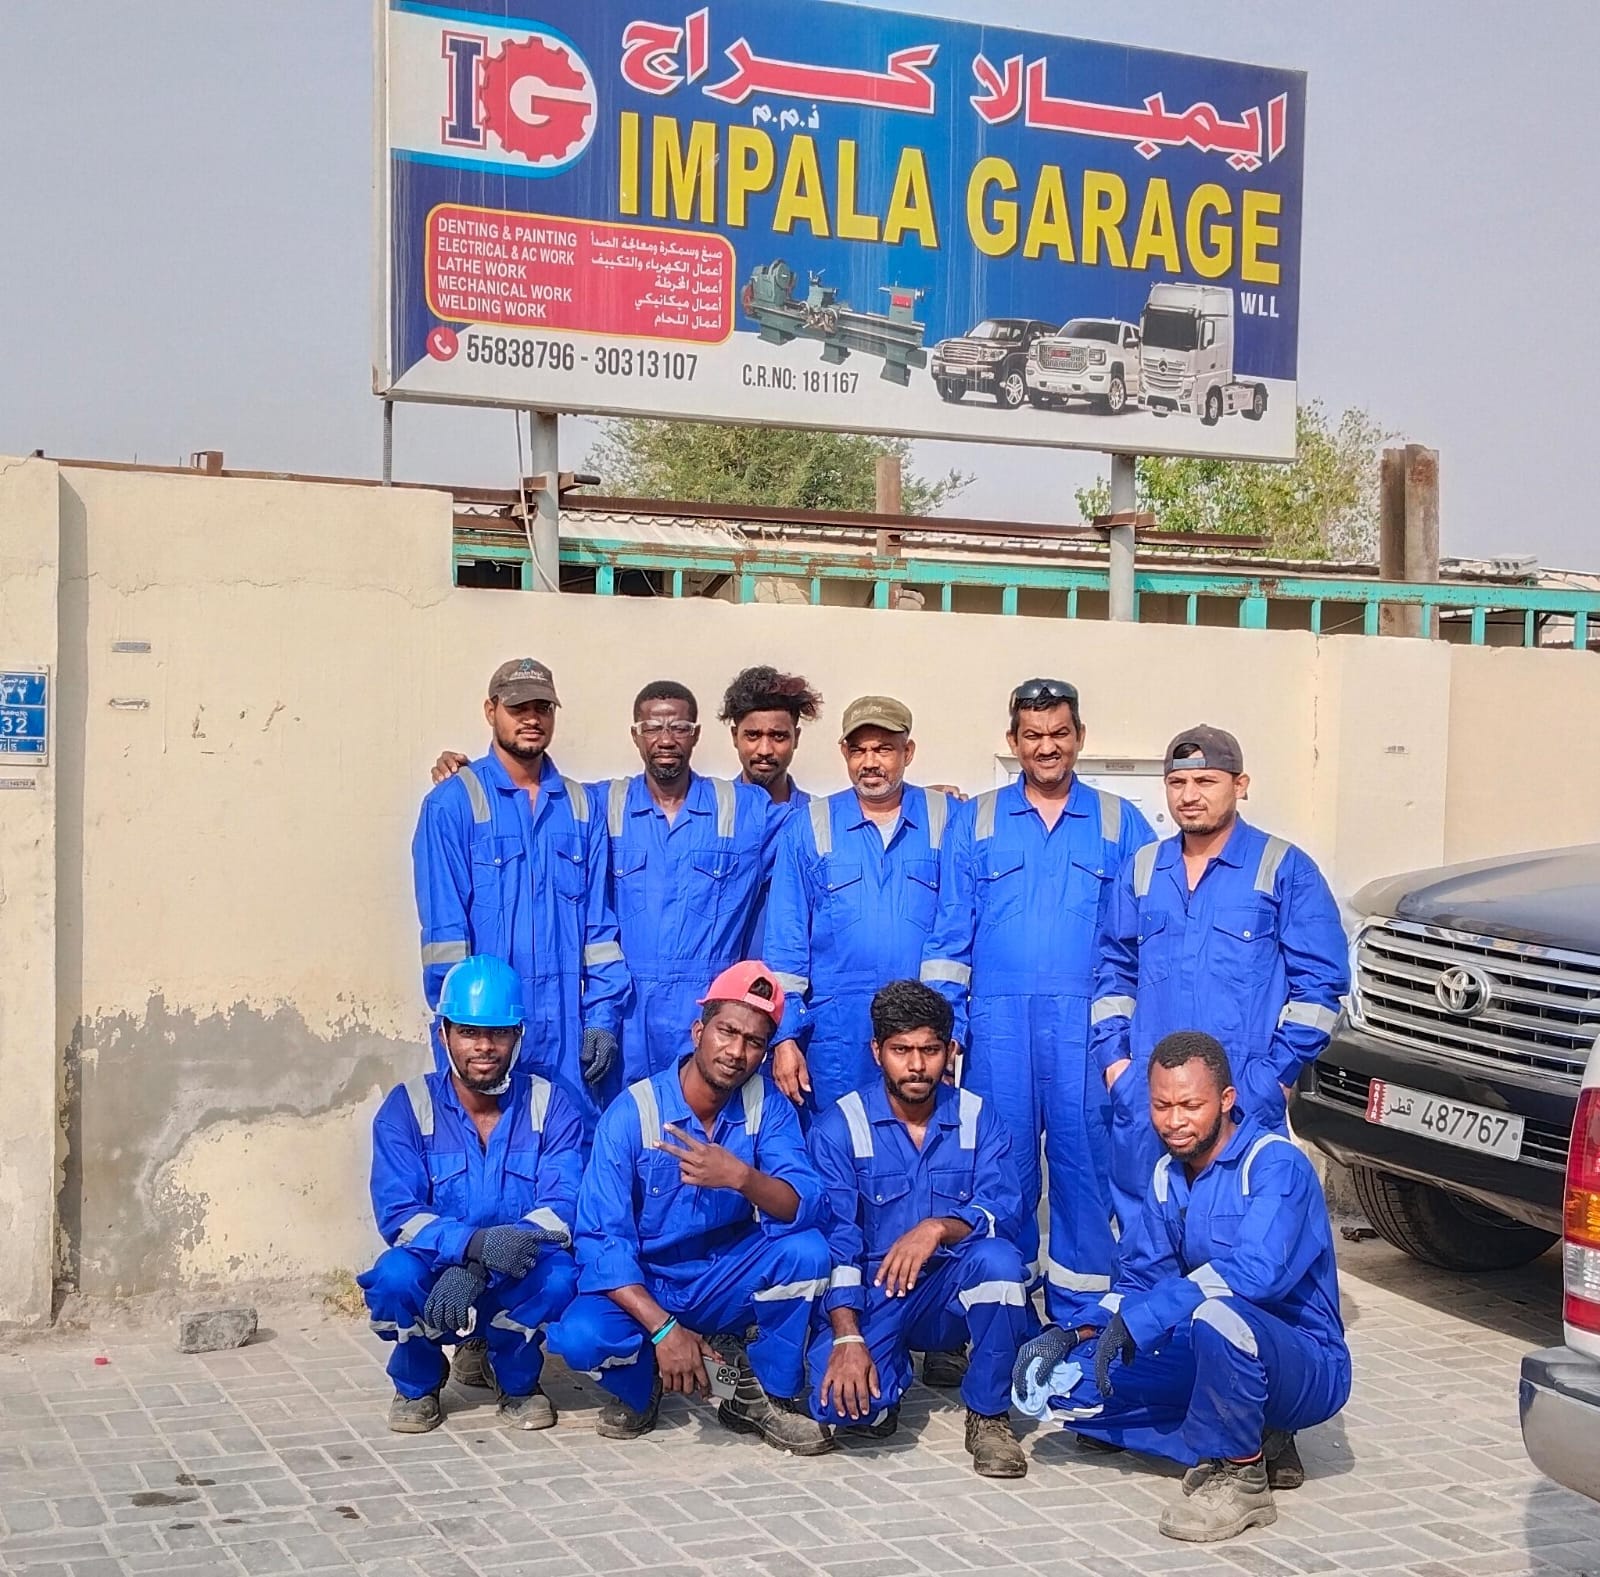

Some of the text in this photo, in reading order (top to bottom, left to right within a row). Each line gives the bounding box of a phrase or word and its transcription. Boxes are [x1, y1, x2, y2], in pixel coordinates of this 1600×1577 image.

[620, 6, 941, 114] كراج
[619, 111, 1281, 285] IMPALA GARAGE
[438, 217, 577, 247] DENTING & PAINTING
[438, 236, 575, 265] ELECTRICAL & AC WORK
[660, 241, 699, 259] وسمكرة
[701, 245, 723, 262] صبغ
[437, 255, 527, 279] LATHE WORK
[591, 253, 723, 277] أعمال الكهرباء والتكييف
[437, 275, 573, 302] MECHANICAL WORK
[691, 279, 722, 294] أعمال
[438, 293, 547, 319] WELDING WORK
[635, 293, 722, 312] أعمال ميكانيكي
[1240, 292, 1280, 318] WLL
[654, 312, 722, 329] أعمال اللحام
[466, 333, 575, 371] 55838796
[594, 347, 698, 382] 30313107
[742, 363, 860, 394] C.R.NO: 181167
[2, 716, 28, 734] 32
[1370, 1083, 1381, 1120] QATAR
[1384, 1097, 1415, 1116] قطر
[1420, 1100, 1509, 1147] 487767
